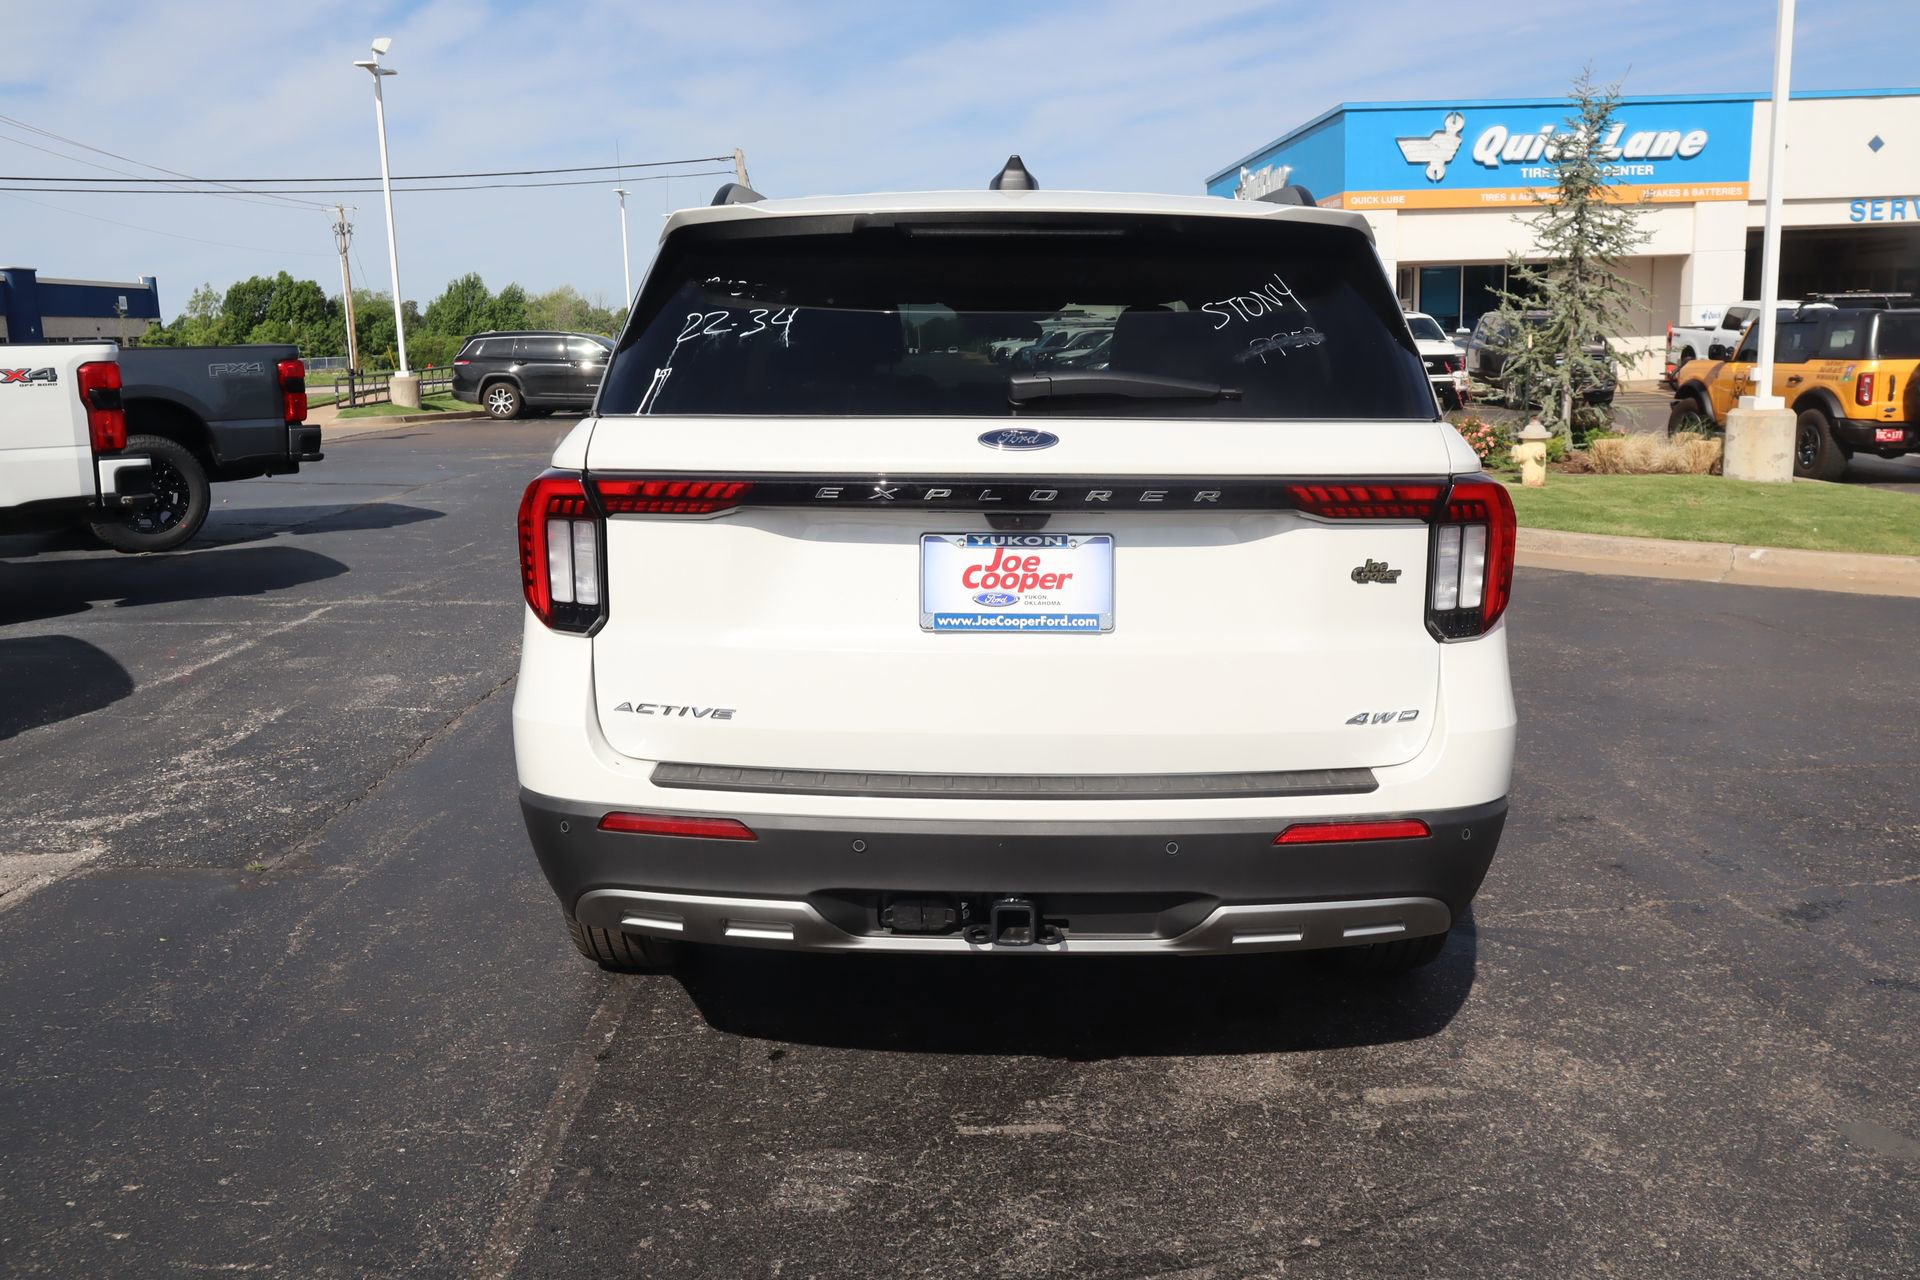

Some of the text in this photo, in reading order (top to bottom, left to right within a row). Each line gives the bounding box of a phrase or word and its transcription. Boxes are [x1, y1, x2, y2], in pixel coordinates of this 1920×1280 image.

[1603, 123, 1707, 158] Lane
[1520, 167, 1551, 179] TIRE
[1603, 165, 1654, 177] CENTER
[1481, 193, 1506, 202] TIRES
[1692, 187, 1743, 197] BATTERIES
[1351, 195, 1379, 206] QUICK
[1382, 195, 1405, 204] LUBE
[815, 486, 1222, 503] EXPLORER
[972, 535, 1063, 546] YUKON
[984, 547, 1041, 573] Joe
[1364, 558, 1389, 573] Joe
[961, 564, 1073, 593] Cooper
[1351, 567, 1402, 582] Cooper
[937, 615, 1098, 629] www.JoeCooperFord.com
[613, 701, 737, 720] ACTIVE
[1345, 709, 1419, 725] 4WD
